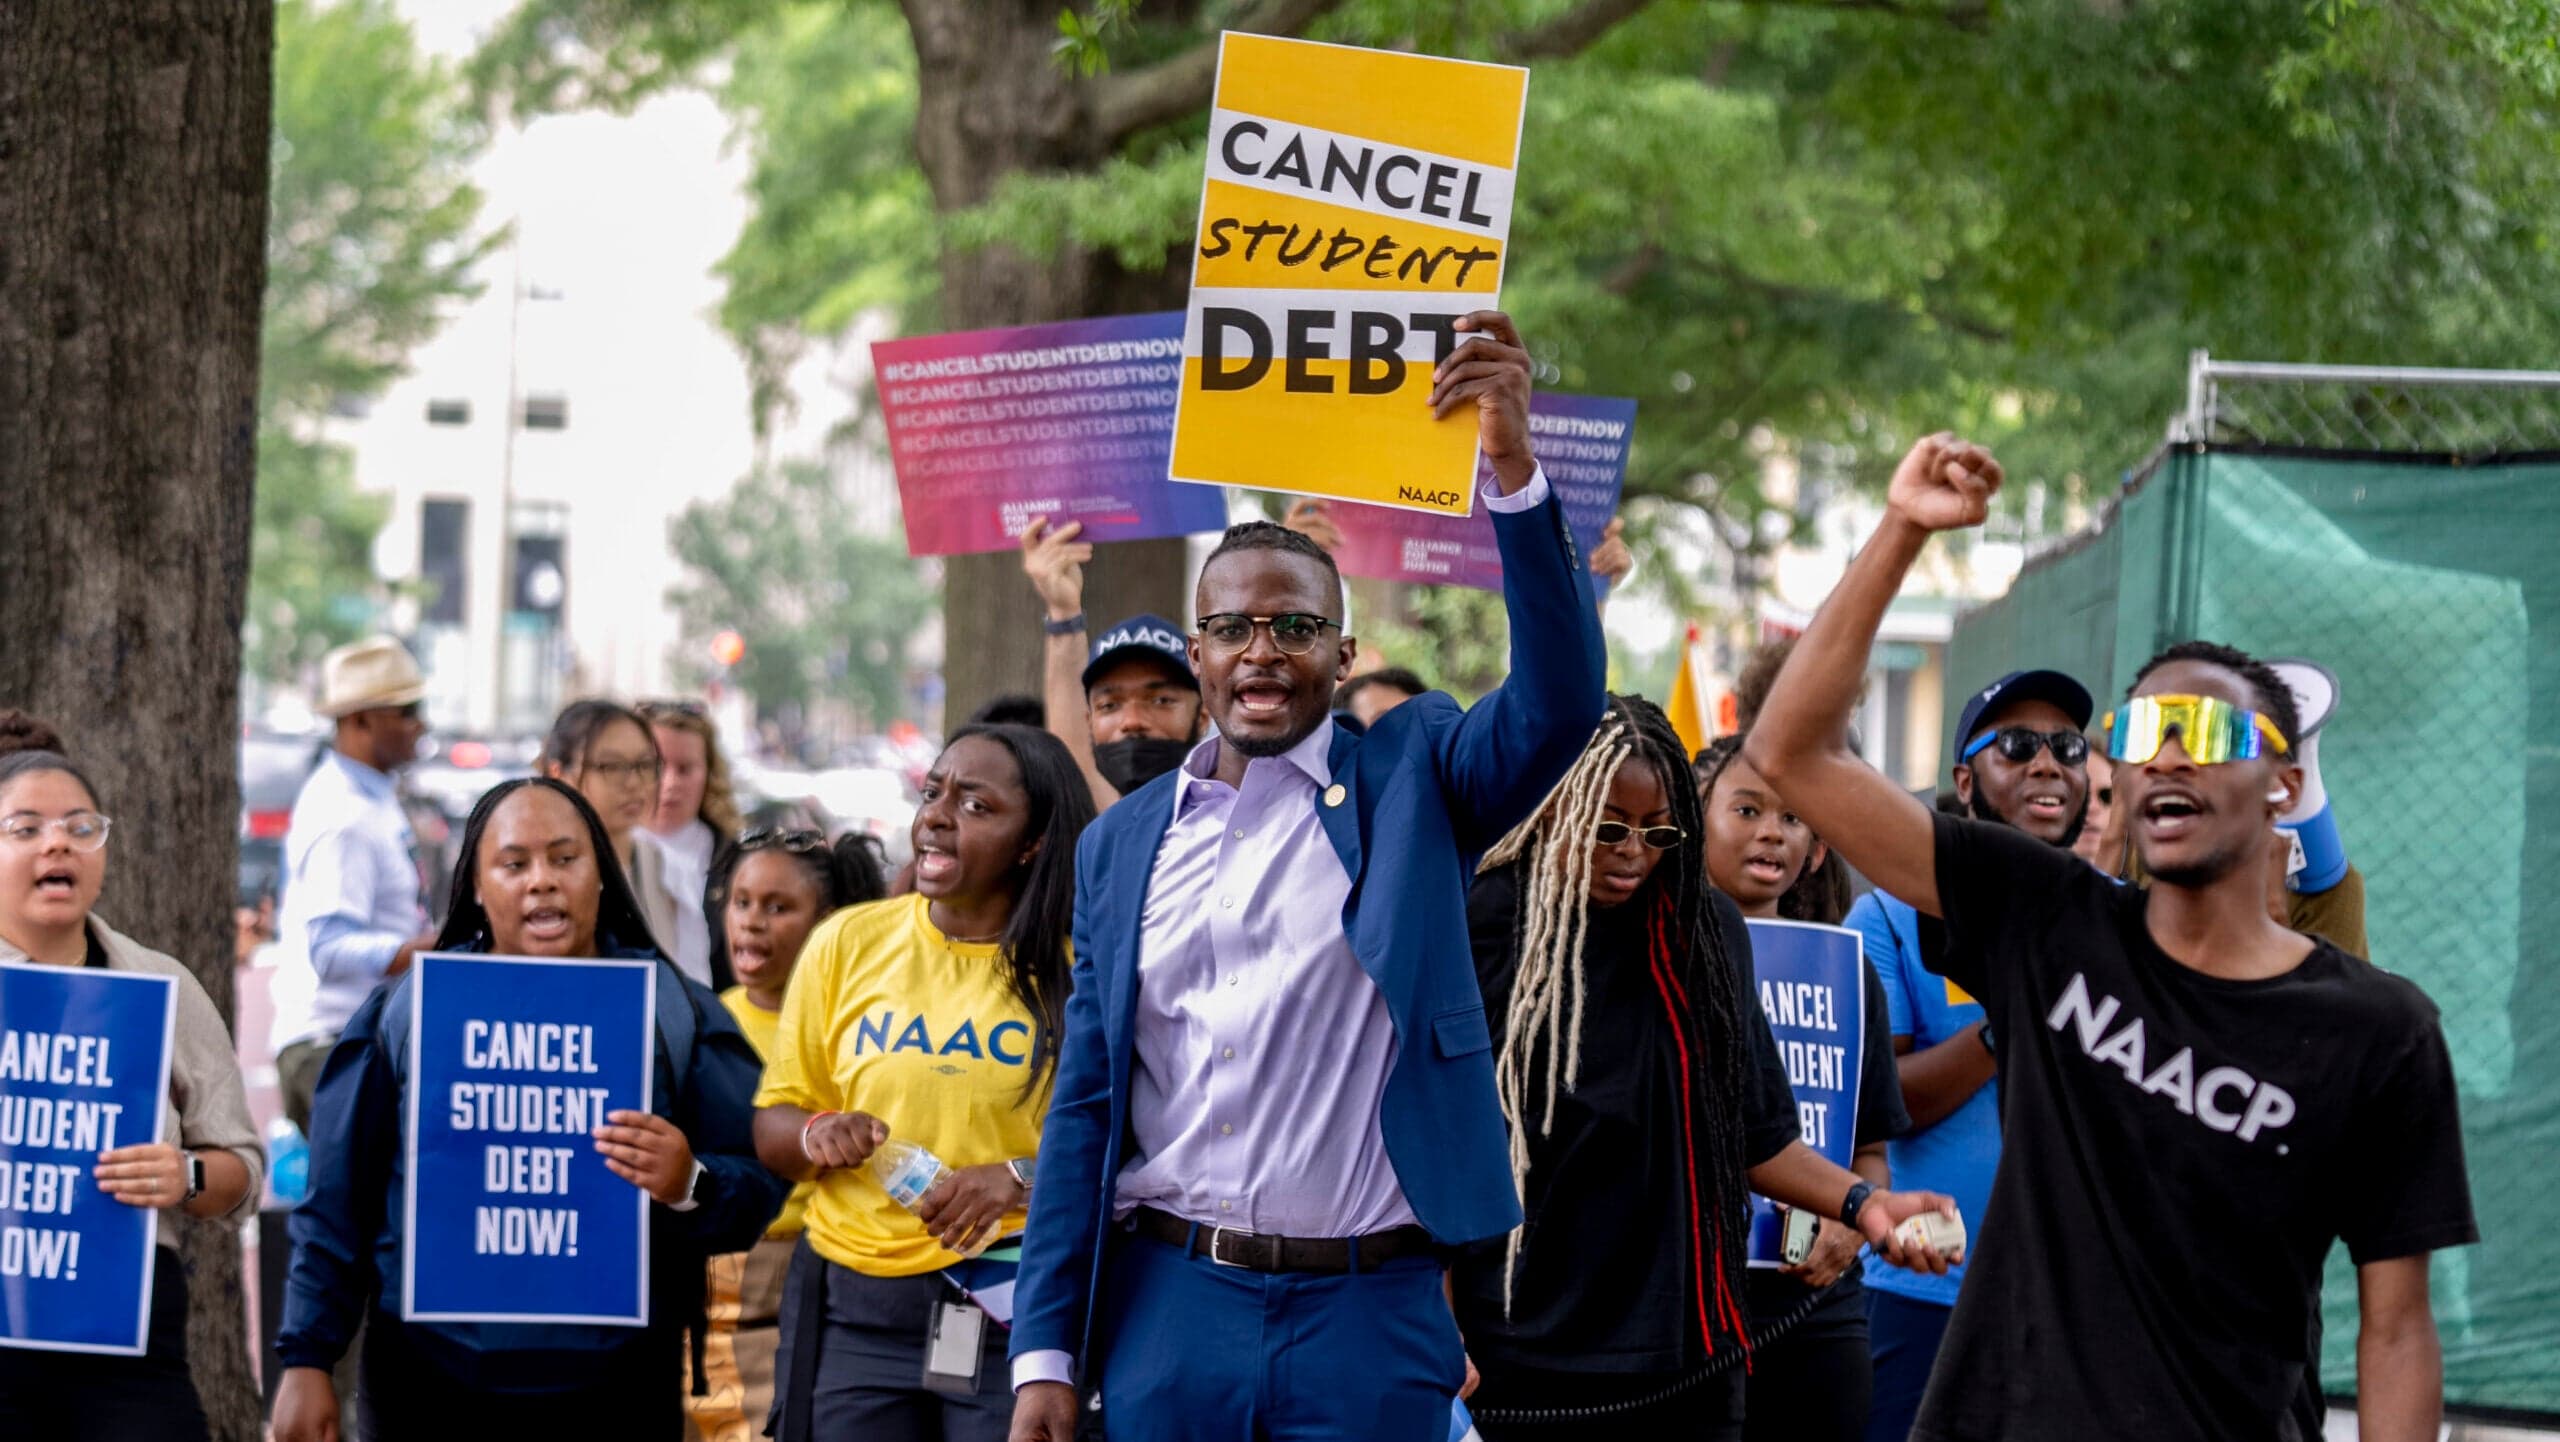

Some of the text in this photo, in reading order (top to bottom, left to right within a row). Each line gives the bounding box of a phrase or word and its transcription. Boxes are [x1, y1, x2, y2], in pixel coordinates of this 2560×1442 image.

[1221, 120, 1492, 229] CANCEL
[1200, 217, 1498, 288] STUDENT
[1200, 306, 1482, 396] DEBT
[895, 388, 1177, 429] #CANCELSTUDENTDEBTNO
[1001, 499, 1061, 515] ALLIANCE
[1398, 485, 1460, 506] NAACP
[1097, 626, 1184, 656] NAACP
[1761, 980, 1838, 1032] ANCEL
[0, 1029, 114, 1088] ANCEL
[462, 1018, 599, 1074] CANCEL
[855, 1010, 1037, 1068] NAAC
[0, 1094, 123, 1151] UDENT
[450, 1081, 609, 1136] STUDENT
[1799, 1101, 1828, 1148] BT
[485, 1144, 574, 1195] DEBT
[1, 1226, 81, 1281] OW!
[475, 1205, 579, 1258] NOW!
